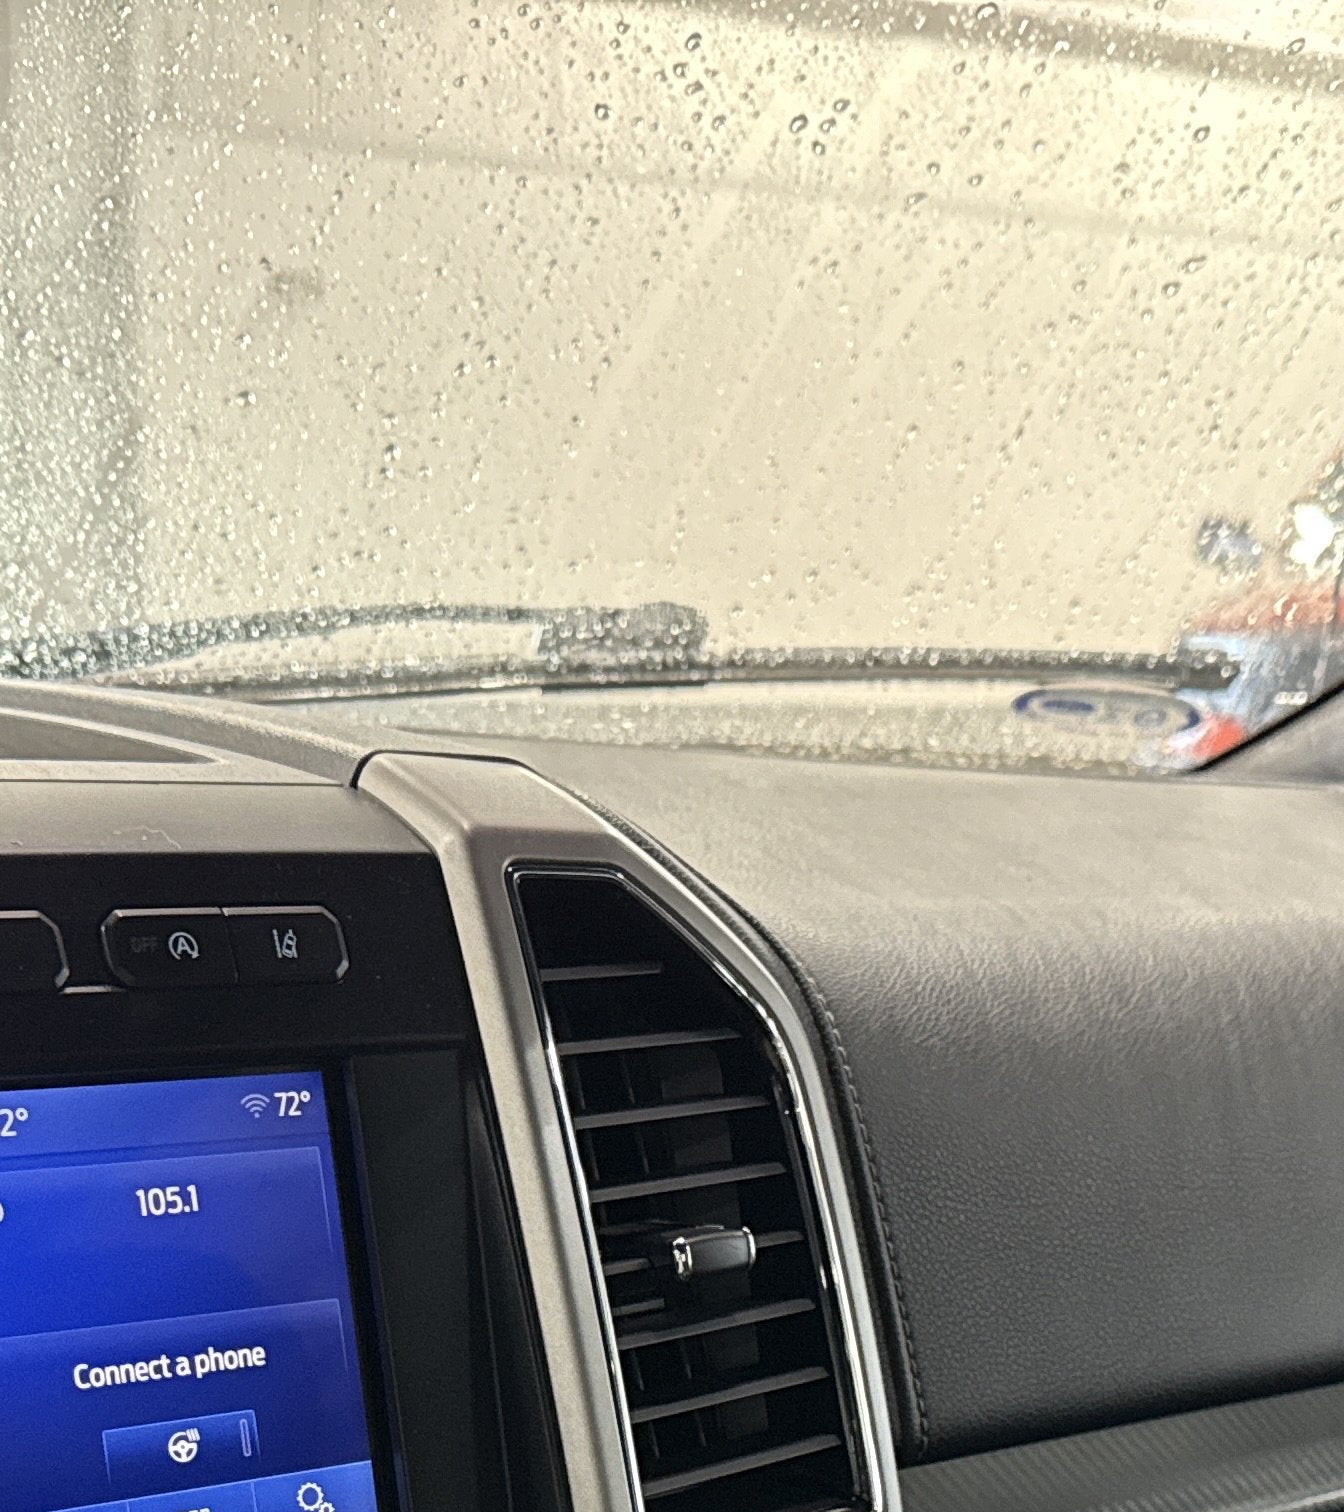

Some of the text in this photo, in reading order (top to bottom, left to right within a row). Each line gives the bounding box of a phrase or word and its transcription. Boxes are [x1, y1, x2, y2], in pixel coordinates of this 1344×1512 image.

[273, 1090, 312, 1118] 72°
[135, 1184, 200, 1217] 105.1
[72, 1345, 267, 1391] Connect a phone
